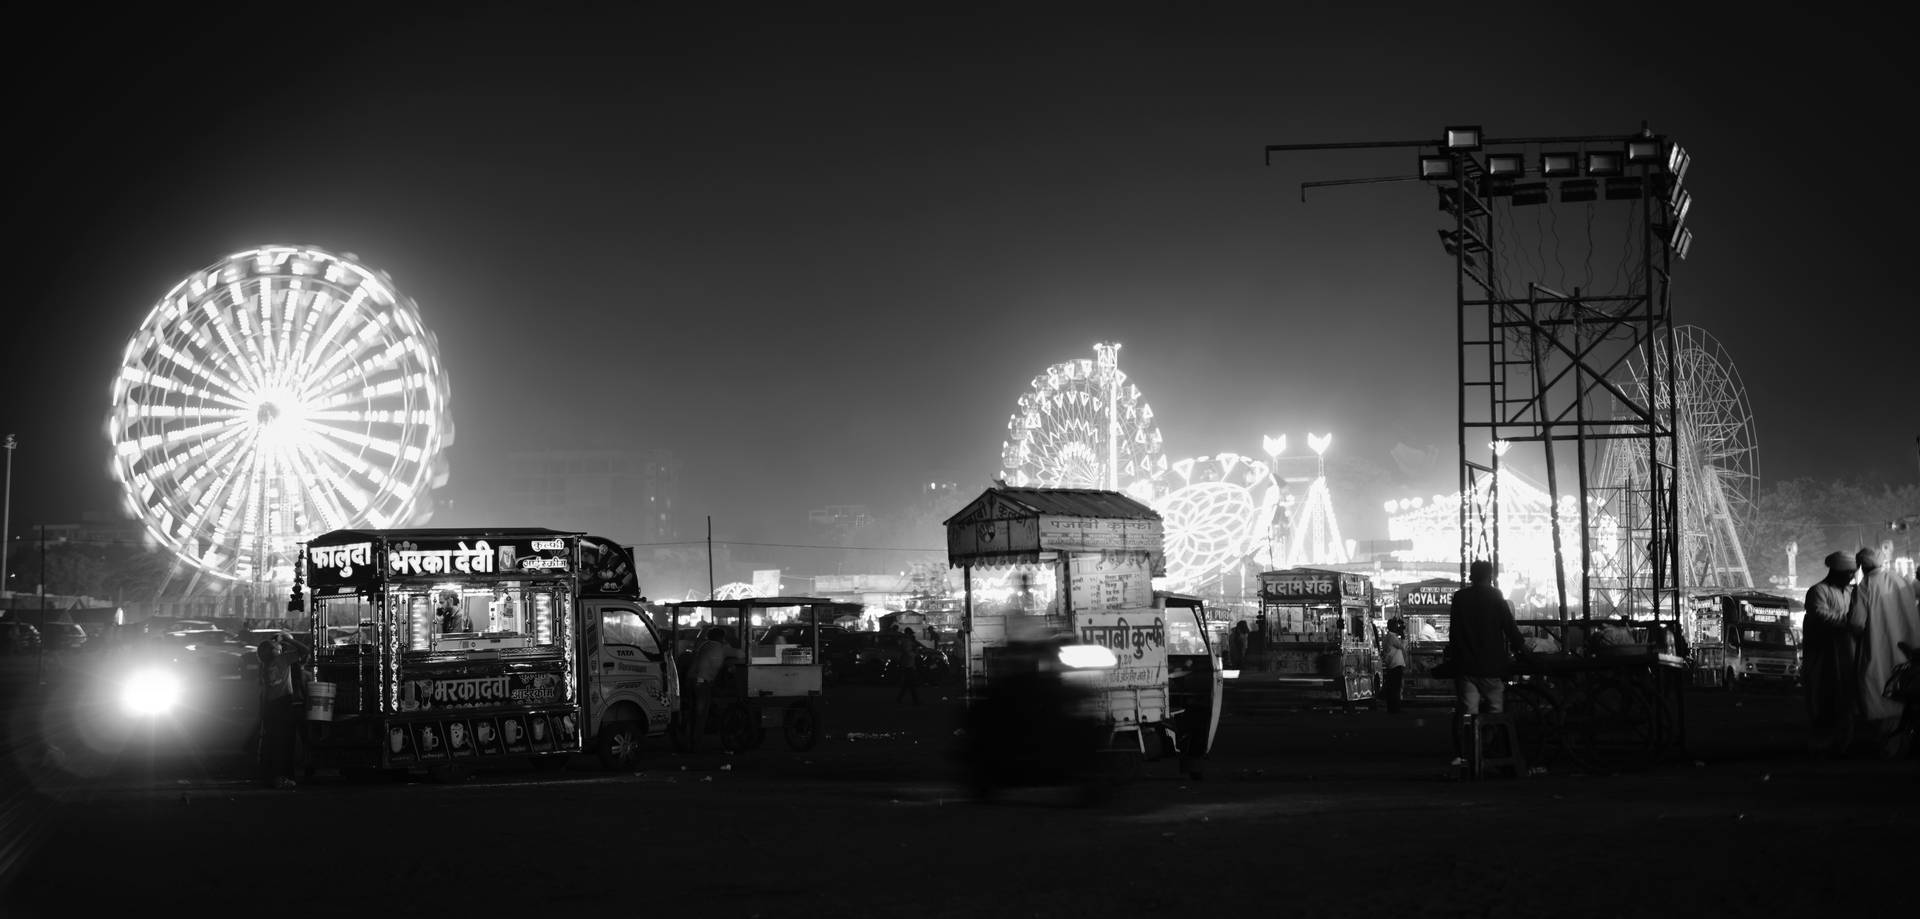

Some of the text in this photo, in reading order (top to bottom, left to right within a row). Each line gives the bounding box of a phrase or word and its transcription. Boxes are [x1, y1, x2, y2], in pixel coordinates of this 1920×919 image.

[309, 542, 372, 577] फालुदा
[1408, 593, 1438, 605] ROYAL
[1081, 617, 1166, 659] पंजाबी कुल्फी
